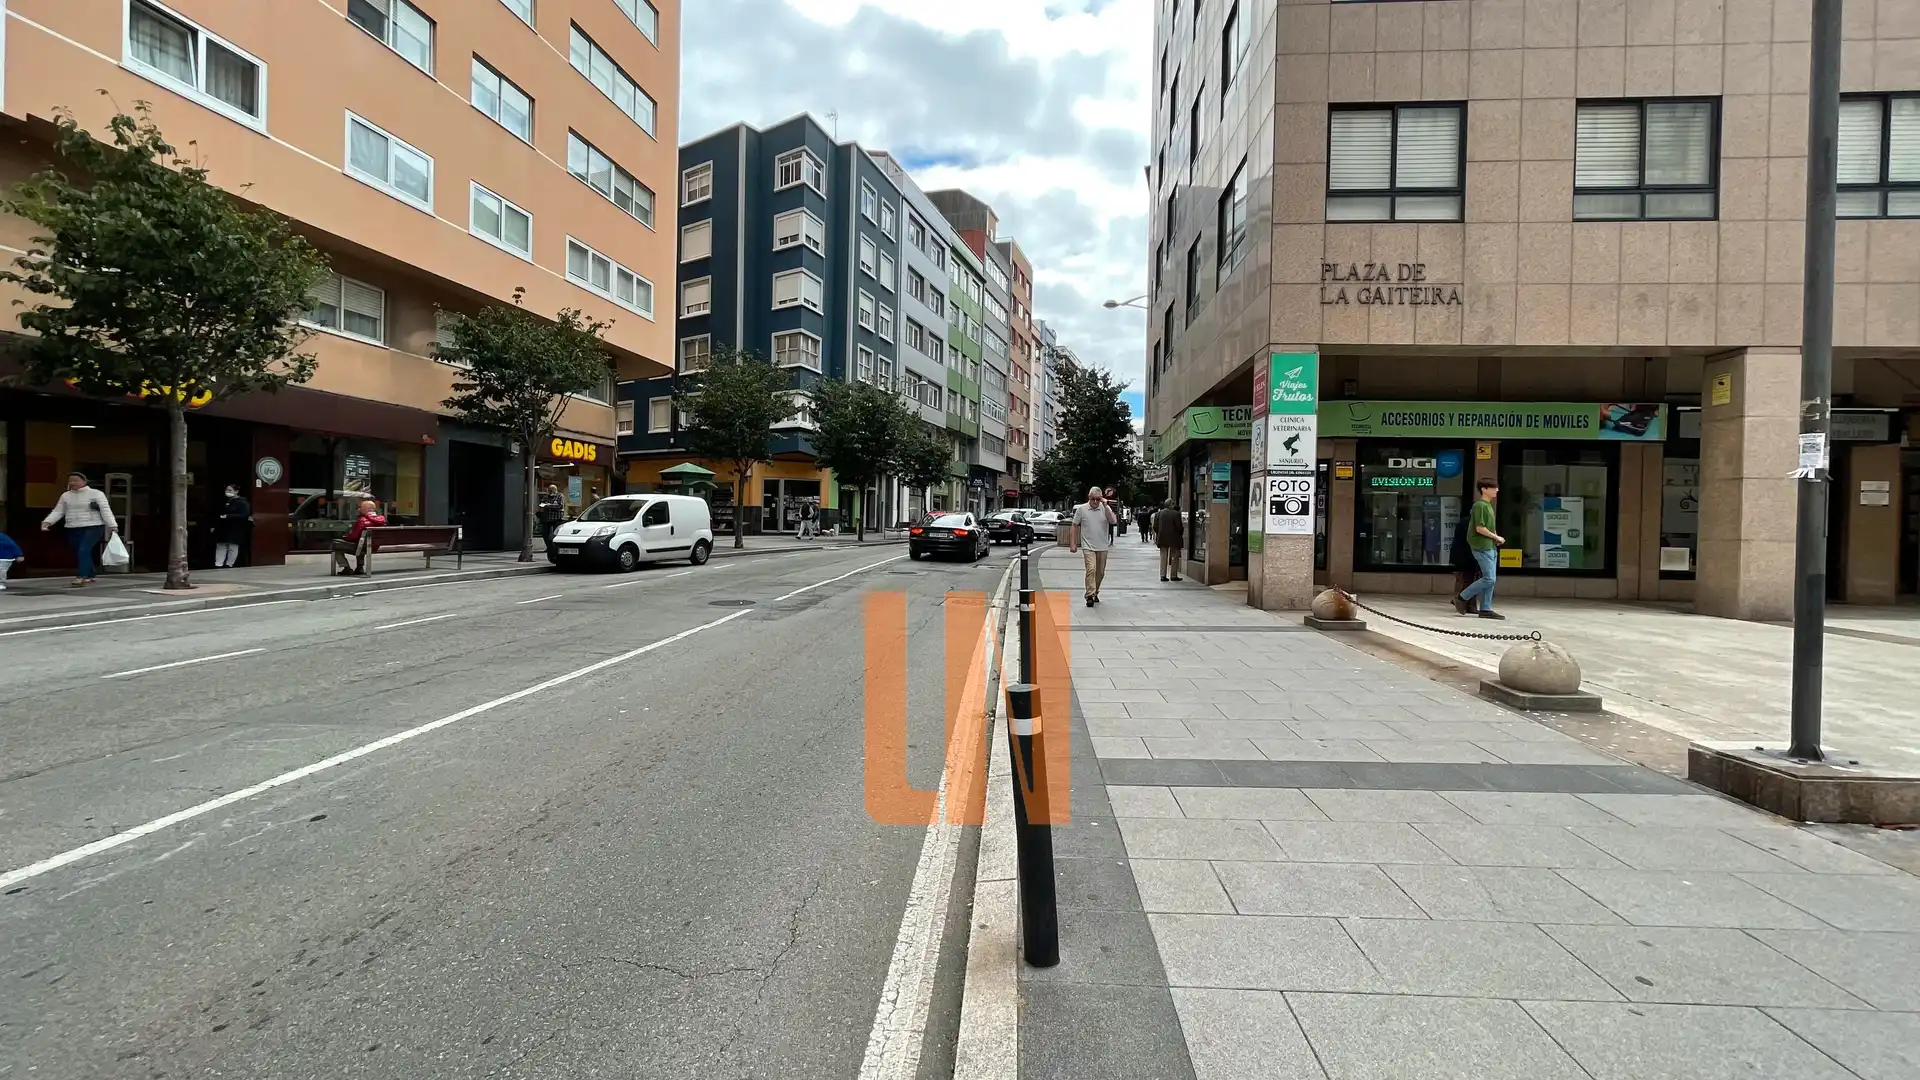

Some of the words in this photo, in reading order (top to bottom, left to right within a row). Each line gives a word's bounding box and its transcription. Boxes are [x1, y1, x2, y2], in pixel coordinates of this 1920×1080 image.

[1320, 263, 1390, 281] PLAZA
[1397, 263, 1427, 281] DE
[1320, 287, 1349, 305] LA
[1356, 287, 1462, 305] GAITEIRA
[1279, 380, 1308, 391] Viajes
[1272, 388, 1314, 402] Frutos
[1381, 412, 1445, 426] ACCESORIOS
[1449, 413, 1455, 426] Y
[1458, 411, 1523, 428] REPARACIÓN
[1526, 414, 1540, 428] DE
[1543, 414, 1589, 428] MOVILES
[551, 438, 596, 461] GADIS
[1388, 458, 1436, 469] DIGI
[1270, 480, 1310, 491] FOTO
[1272, 517, 1307, 528] tempo
